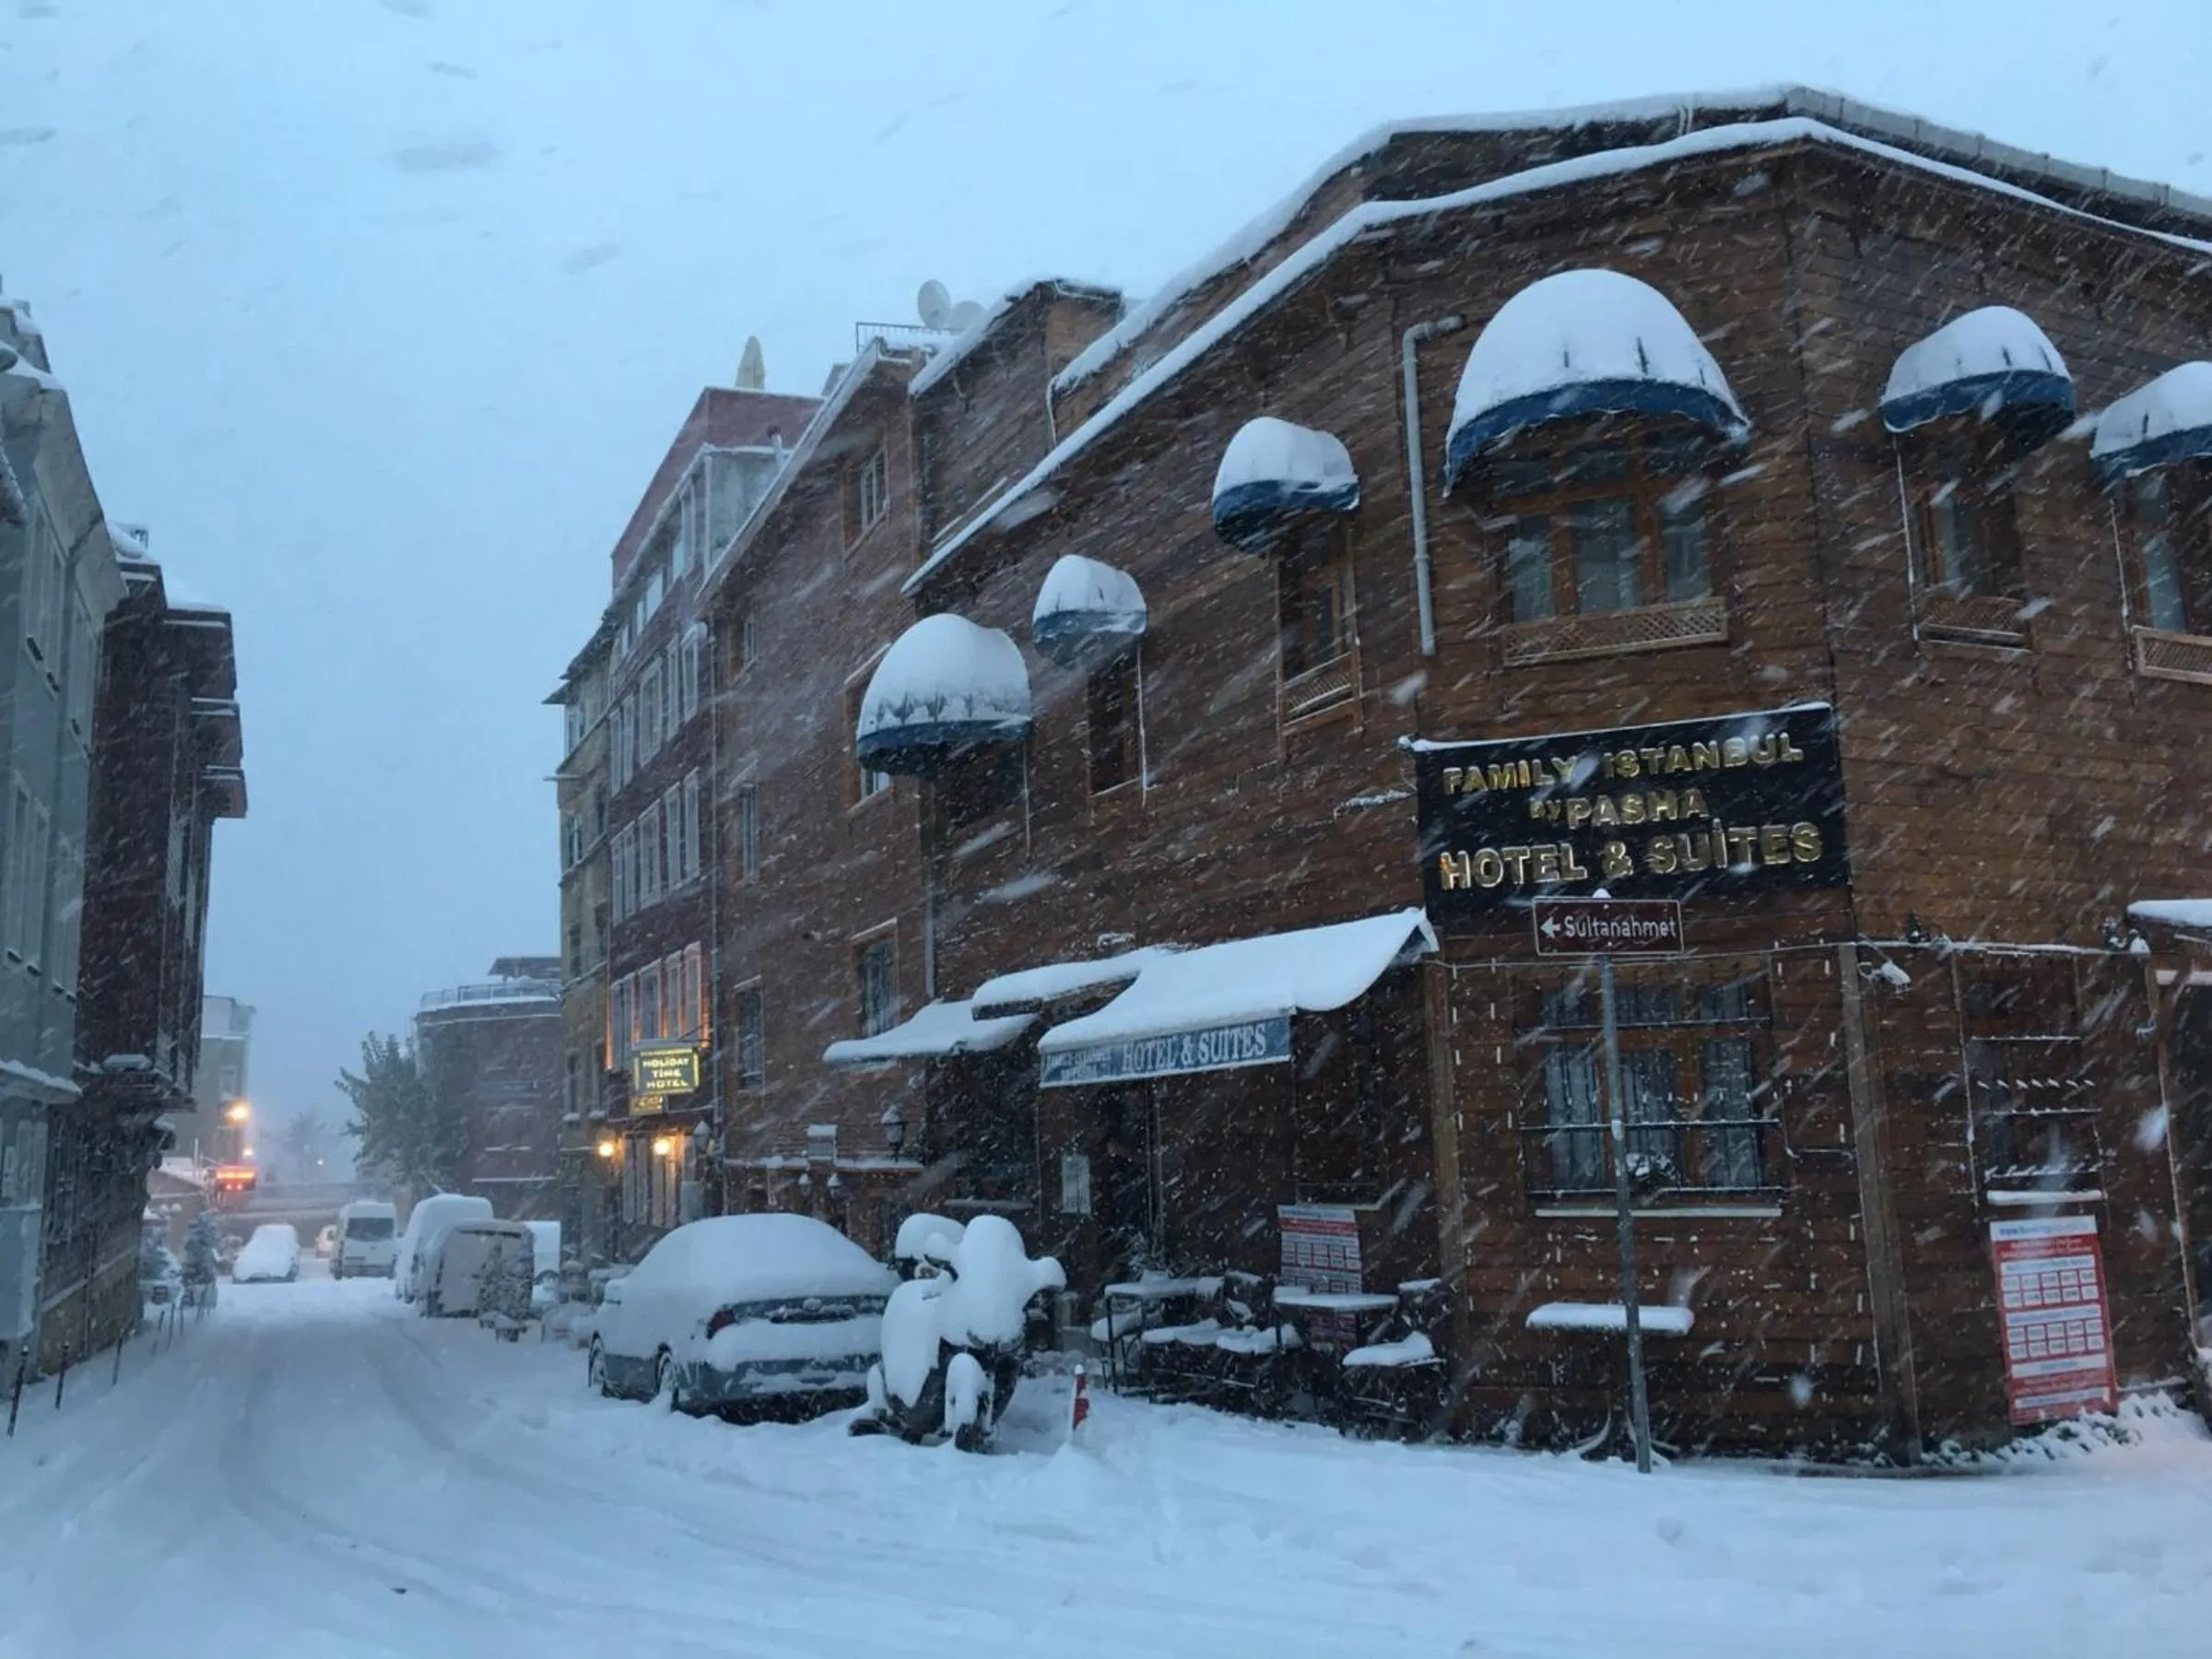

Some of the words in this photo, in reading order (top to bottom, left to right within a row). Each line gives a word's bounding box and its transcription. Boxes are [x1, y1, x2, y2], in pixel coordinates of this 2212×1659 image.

[1442, 754, 1579, 795] FAMILY
[1567, 787, 1710, 830] PASHA
[1440, 842, 1588, 889] HOTEL
[1602, 840, 1634, 879] &
[1563, 913, 1677, 938] Sultanahmet
[1122, 1036, 1177, 1073] HOTEL
[1181, 1034, 1197, 1065] &
[646, 1079, 689, 1088] HOTEL
